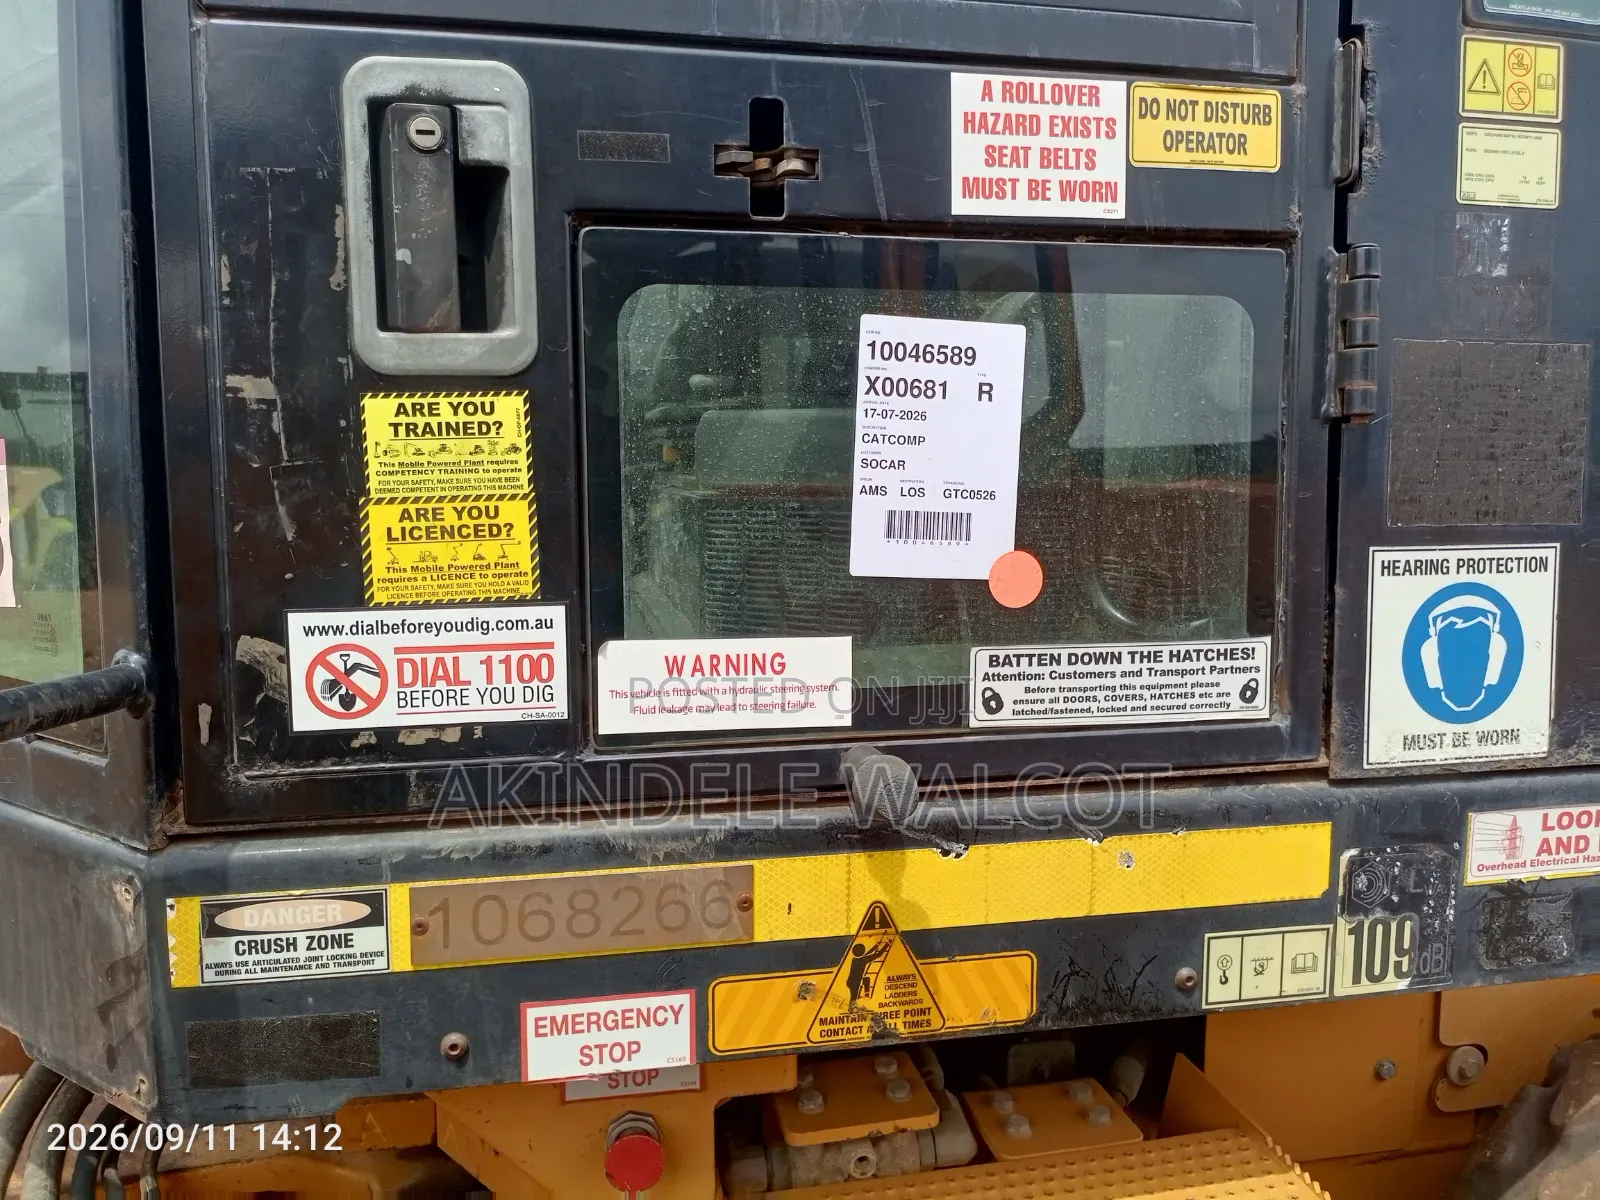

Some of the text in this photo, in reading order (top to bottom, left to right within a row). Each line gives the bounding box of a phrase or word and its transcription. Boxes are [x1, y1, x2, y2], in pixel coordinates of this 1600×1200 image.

[981, 80, 1100, 106] A ROLLOVER
[1138, 97, 1272, 126] DO NOT DISTURB
[964, 112, 1116, 139] HAZARD EXISTS
[1163, 131, 1247, 155] OPERATOR
[984, 145, 1096, 171] SEAT BELTS
[962, 177, 1118, 203] MUST BE WORN
[868, 341, 976, 366] 10046589
[865, 376, 947, 399] X00681
[978, 382, 994, 402] R
[395, 401, 495, 417] ARE YOU
[864, 408, 927, 421] 17-07-2026
[389, 421, 503, 438] TRAINED?
[862, 433, 926, 446] CATCOMP
[861, 459, 906, 470] SOCAR
[860, 485, 887, 496] AMS
[900, 487, 925, 498] LOS
[943, 489, 996, 500] GTC0526
[399, 505, 499, 523] ARE YOU
[387, 523, 513, 541] LICENCED?
[411, 564, 444, 572] Mobile
[448, 562, 491, 571] Powered
[494, 562, 519, 570] Plant
[1381, 556, 1548, 576] HEARING PROTECTION
[377, 576, 418, 584] requires
[430, 573, 476, 582] LICENCE
[492, 571, 528, 579] operate
[304, 618, 553, 636] www.dialbeforeyoudig.com.au
[665, 653, 786, 677] WARNING
[989, 647, 1255, 668] BATTEN DOWN THE HATCHES!
[397, 654, 554, 688] DIAL 1100
[982, 665, 1260, 682] Attention: Customers and Transport Partners
[397, 685, 554, 708] BEFORE YOU DIG
[609, 690, 628, 699] This
[630, 689, 660, 698] vehicle
[664, 688, 670, 697] is
[672, 688, 698, 697] fitted
[700, 686, 719, 696] with
[729, 685, 768, 696] hydraulic
[770, 684, 804, 694] steering
[807, 684, 839, 694] system.
[1024, 686, 1056, 694] Before
[1059, 684, 1116, 693] transporting
[1140, 682, 1188, 690] equipment
[1190, 681, 1220, 689] please
[1063, 695, 1101, 704] DOORS,
[1104, 694, 1147, 702] COVERS,
[1150, 692, 1196, 700] HATCHES
[634, 705, 655, 715] Fluid
[659, 705, 693, 715] leakage
[696, 705, 715, 714] may
[718, 703, 736, 712] lead
[750, 701, 786, 711] steering
[787, 700, 816, 709] failure.
[1012, 706, 1094, 716] latched/fastened,
[1097, 705, 1128, 713] locked
[1130, 704, 1148, 712] and
[1150, 703, 1187, 711] secured
[1189, 701, 1231, 710] correctly
[1403, 729, 1520, 751] MUST BE WORN
[1536, 834, 1590, 857] AND
[1477, 856, 1579, 872] Overhead Electrical
[244, 904, 342, 927] DANGER
[428, 880, 734, 949] 1068266
[235, 933, 354, 956] CRUSH ZONE
[1348, 914, 1444, 985] 109 dB
[205, 962, 233, 970] ALWAYS
[252, 957, 300, 966] ARTICULATED
[326, 953, 357, 961] LOCKING
[214, 969, 242, 977] DURING
[260, 964, 312, 973] MAINTENANCE
[333, 959, 375, 968] TRANSPORT
[885, 982, 918, 990] DESCEND
[887, 973, 916, 982] ALWAYS
[878, 998, 924, 1008] BACKWARDS
[884, 990, 918, 999] LADDERS
[534, 1005, 683, 1037] EMERGENCY
[904, 1007, 932, 1017] POINT
[820, 1026, 863, 1038] CONTACT
[903, 1018, 932, 1030] TIMES
[580, 1041, 641, 1066] STOP
[606, 1069, 659, 1089] STOP
